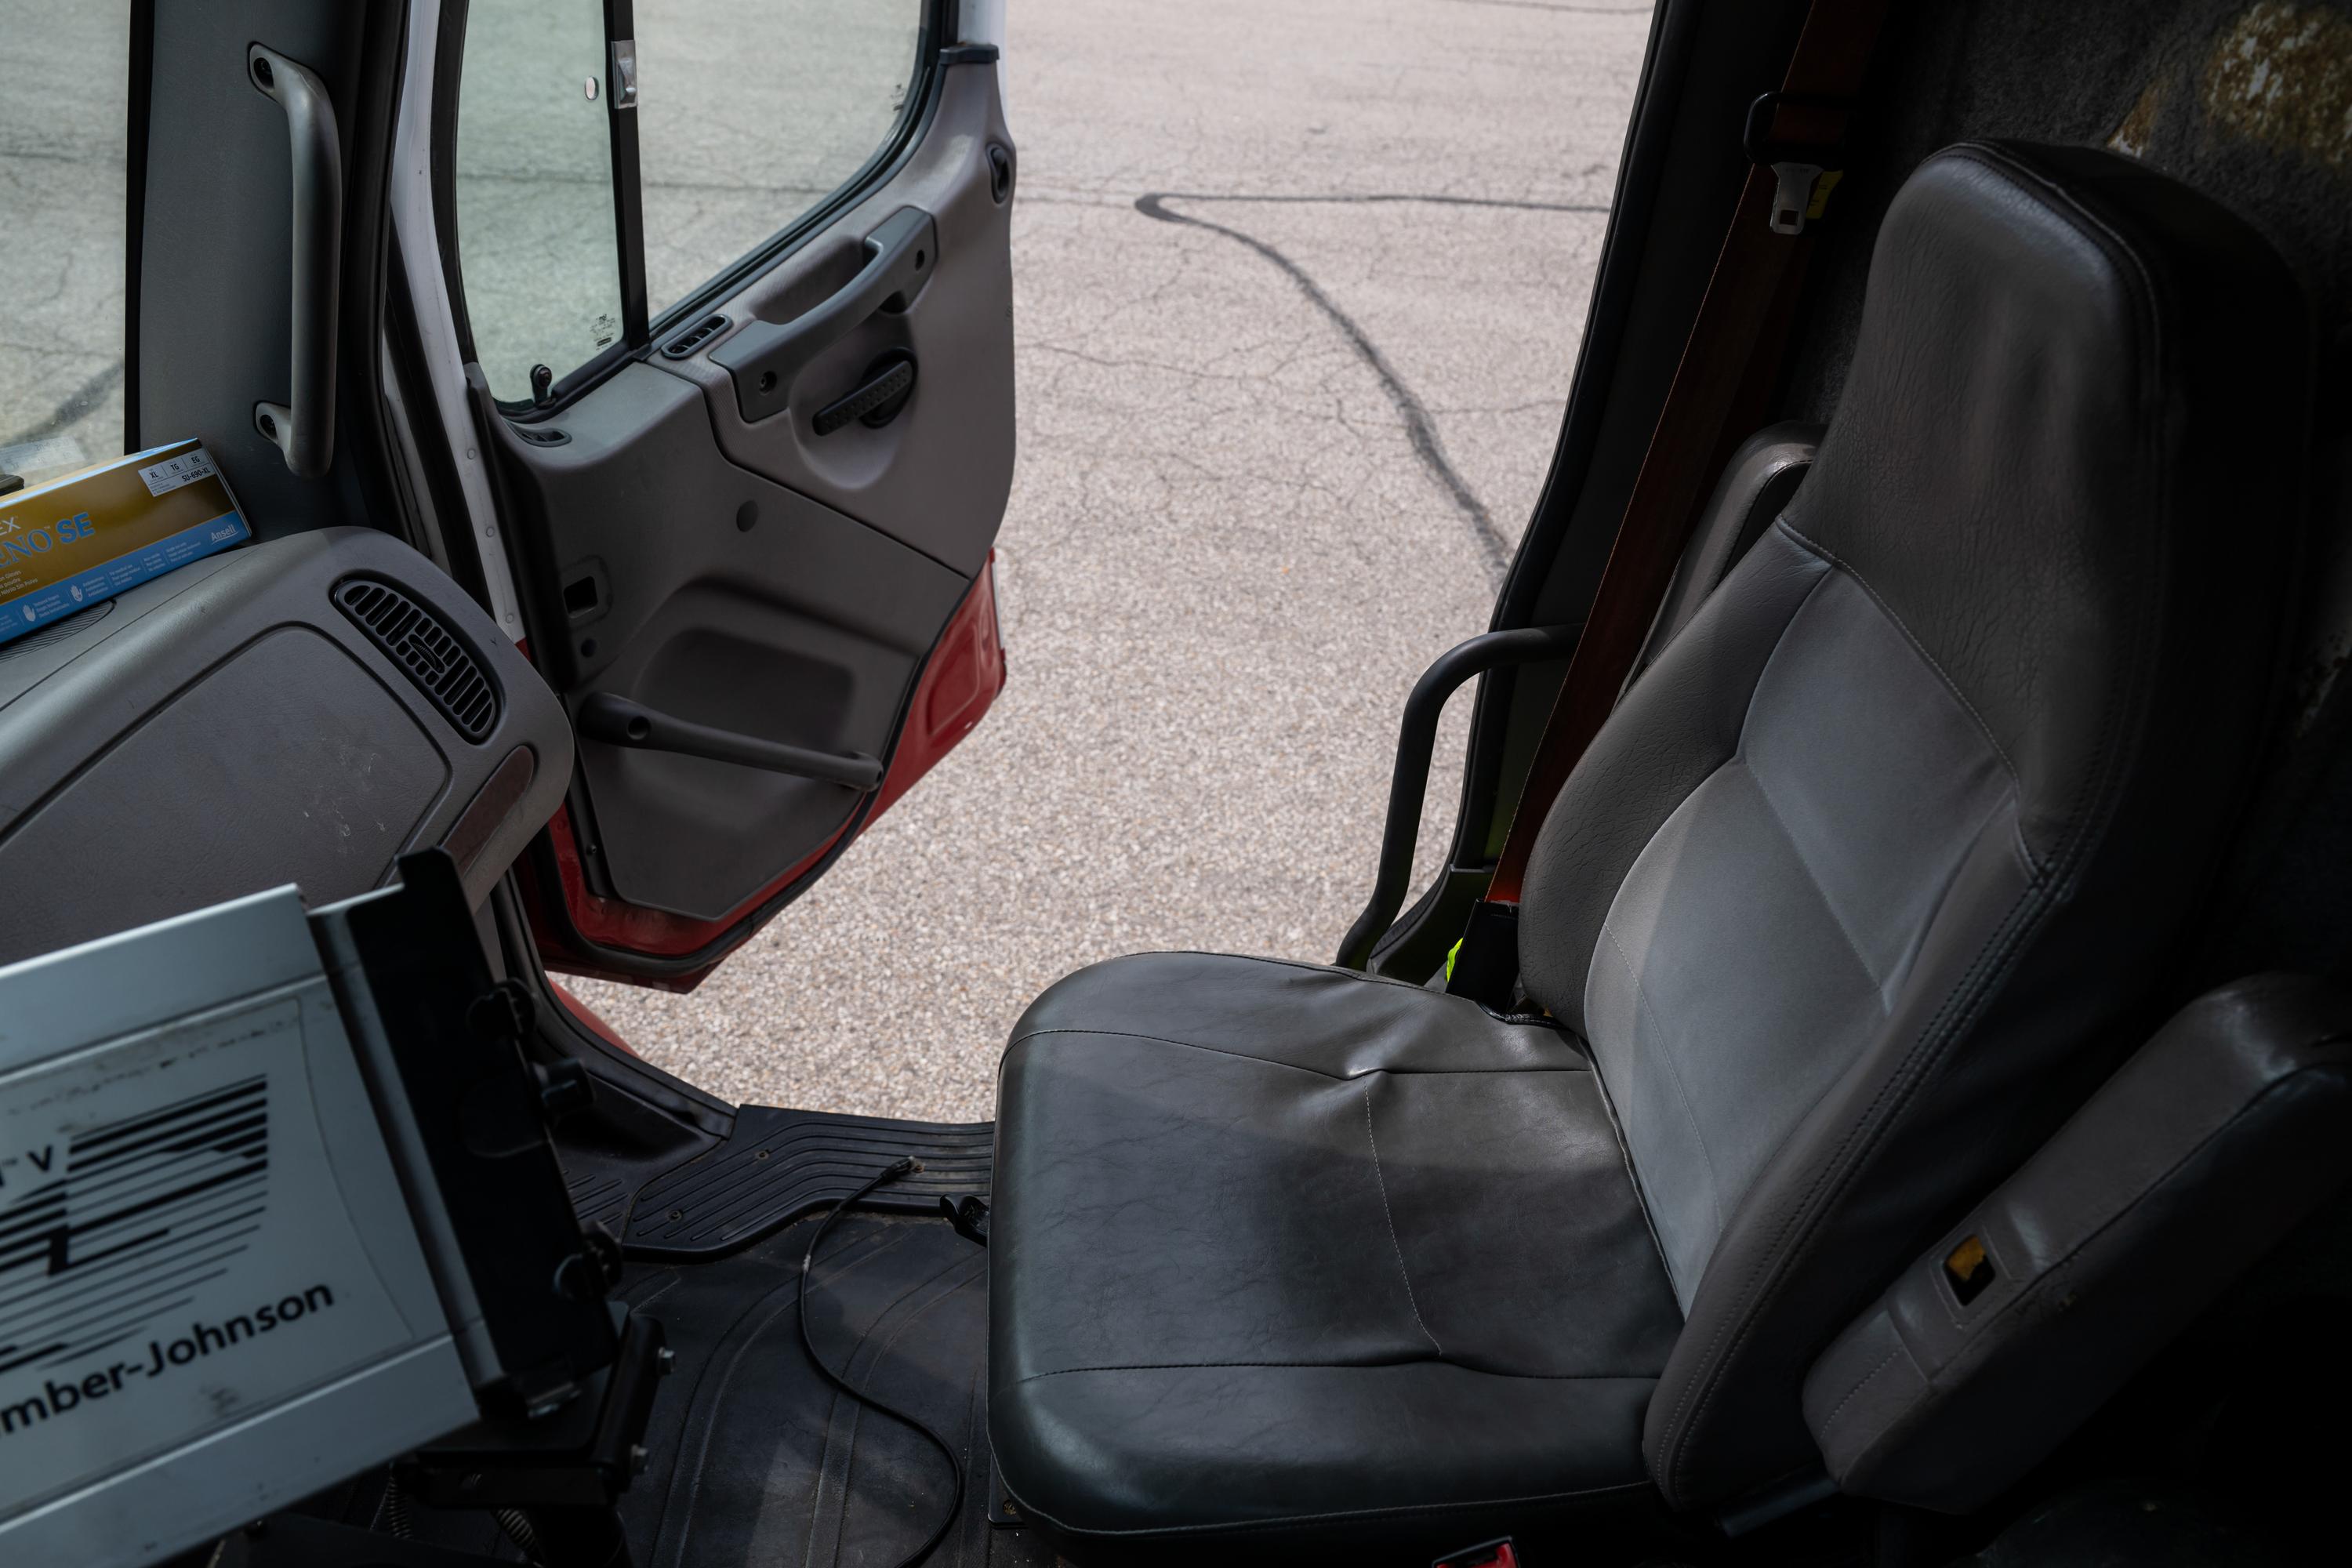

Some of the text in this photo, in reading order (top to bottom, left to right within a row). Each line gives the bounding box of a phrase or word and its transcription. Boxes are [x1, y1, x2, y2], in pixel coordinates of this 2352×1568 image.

[182, 467, 210, 482] SU-690-XL
[56, 512, 95, 544] SE
[211, 524, 235, 542] Ansell
[27, 1145, 53, 1174] V
[0, 1284, 334, 1436] mber-Johnson
